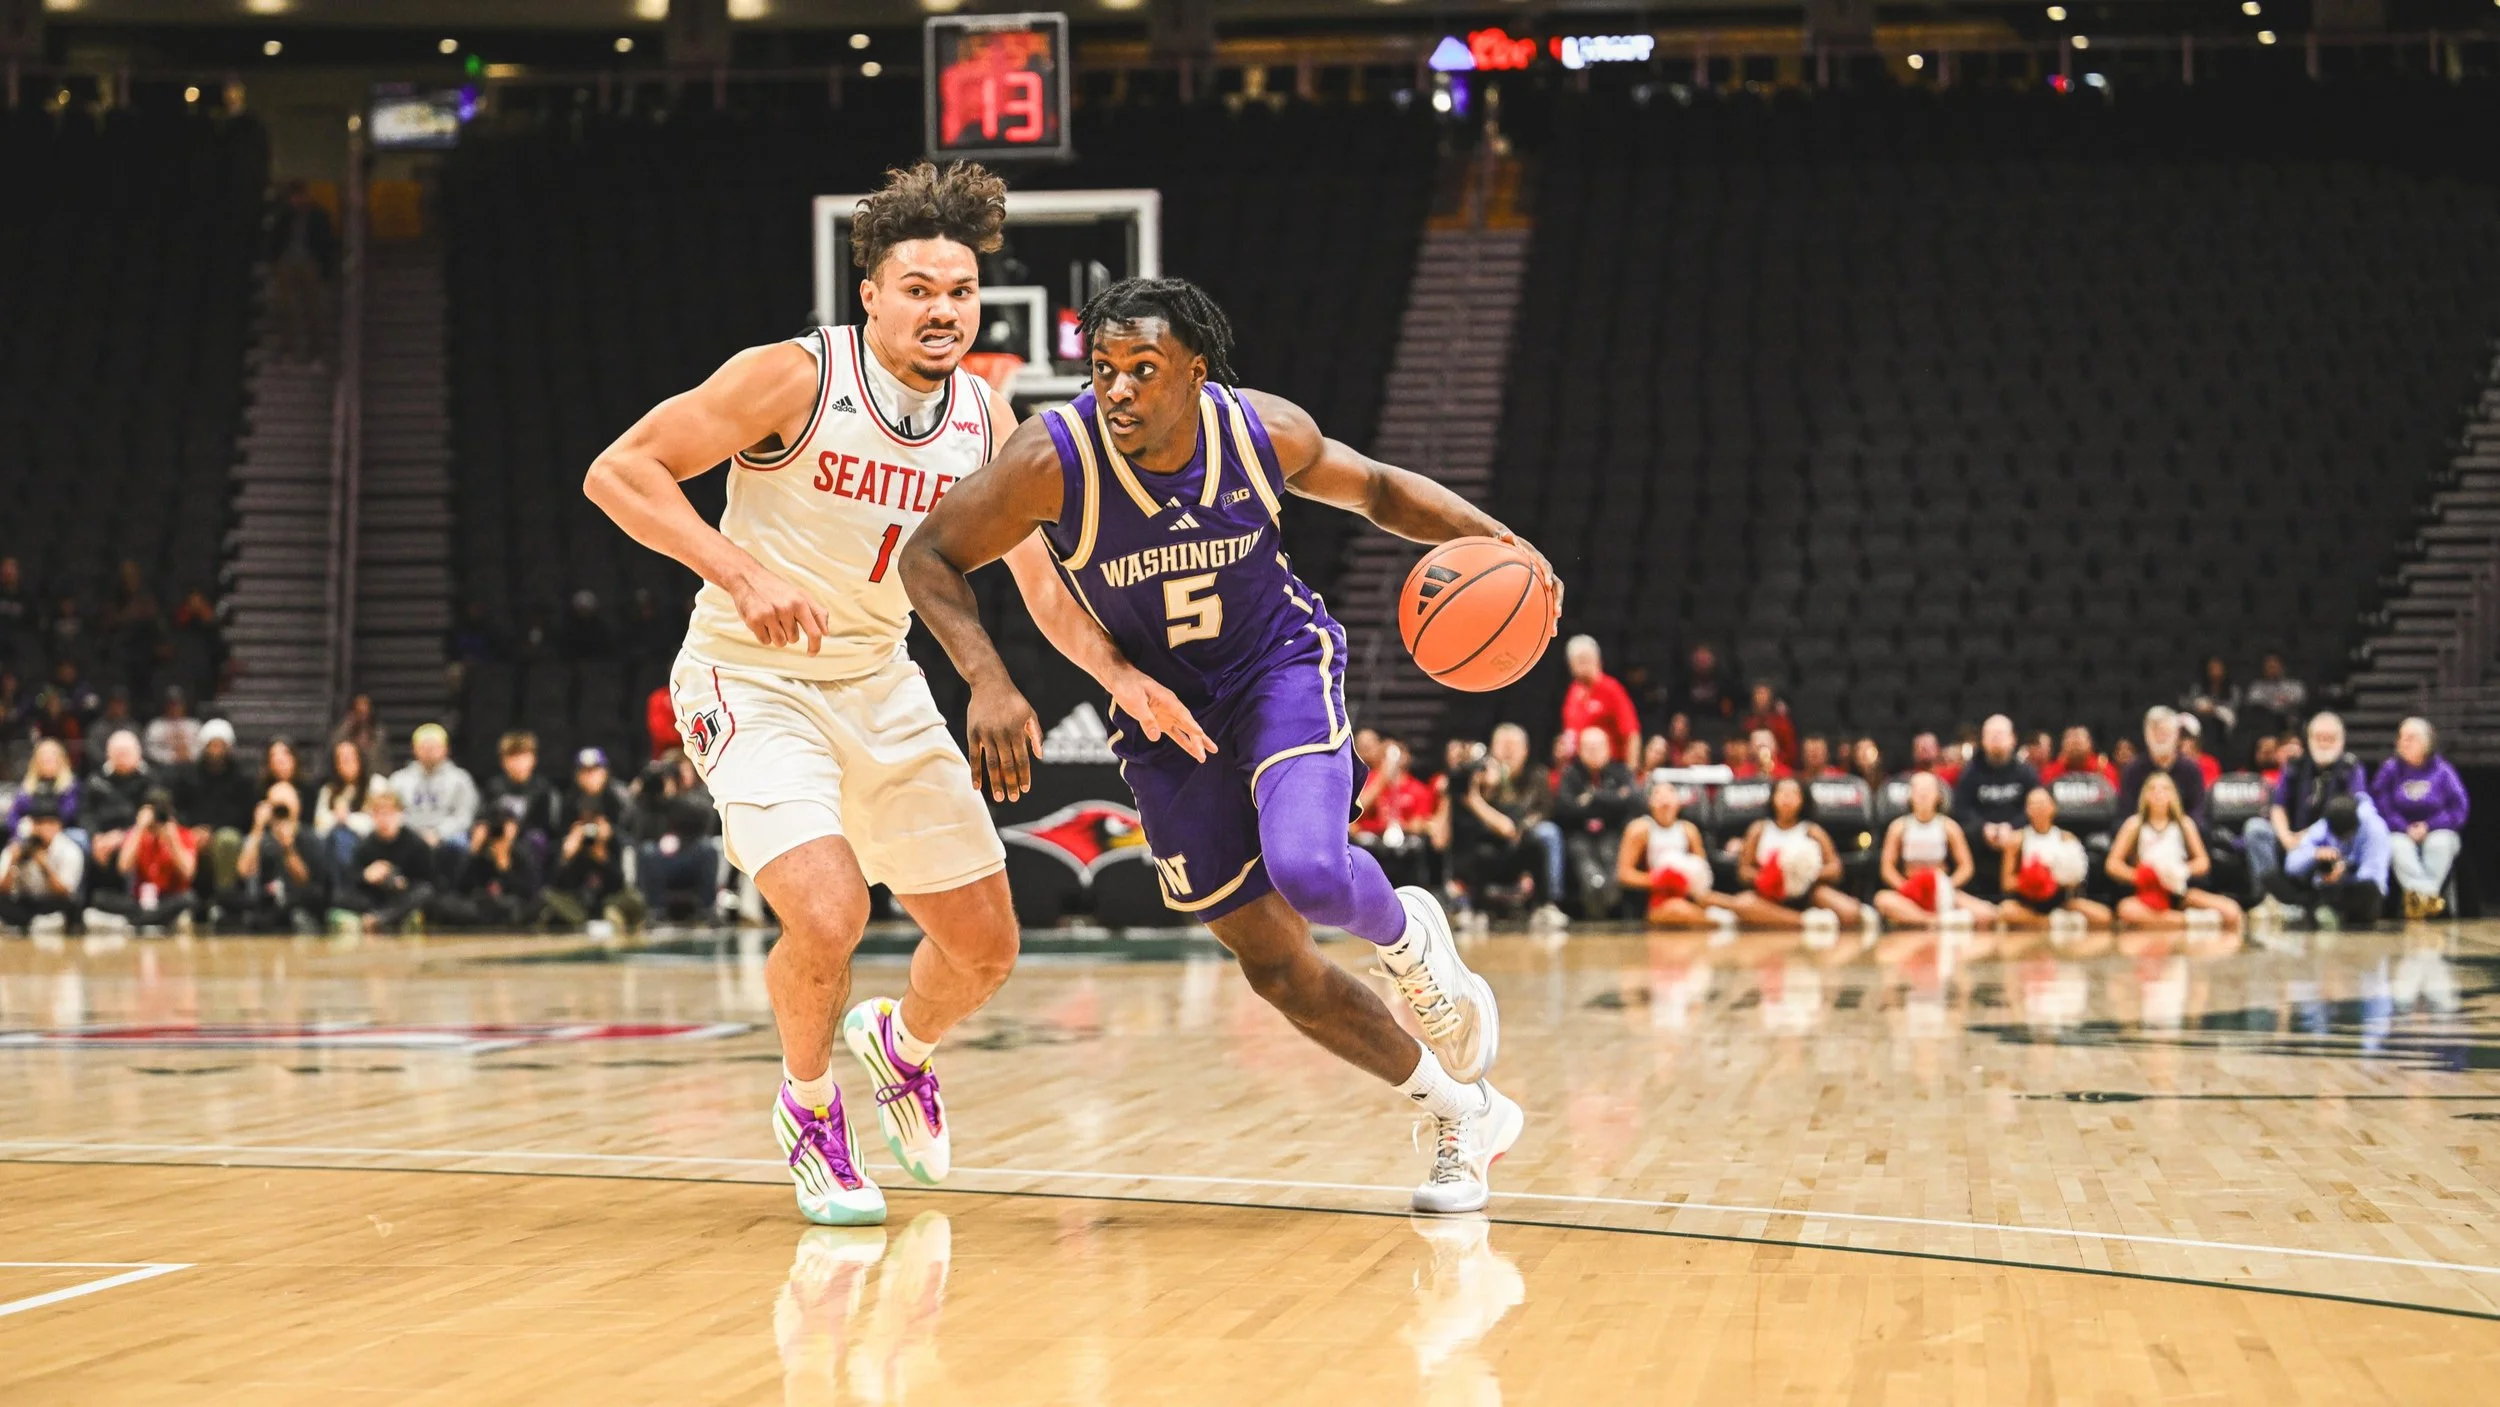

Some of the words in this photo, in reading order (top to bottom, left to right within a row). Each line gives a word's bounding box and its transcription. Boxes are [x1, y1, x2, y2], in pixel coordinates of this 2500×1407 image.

[832, 403, 857, 414] adidas
[952, 420, 980, 435] WCC
[868, 523, 903, 583] 1
[1099, 526, 1264, 587] WASHINGTON
[1162, 572, 1223, 649] 5
